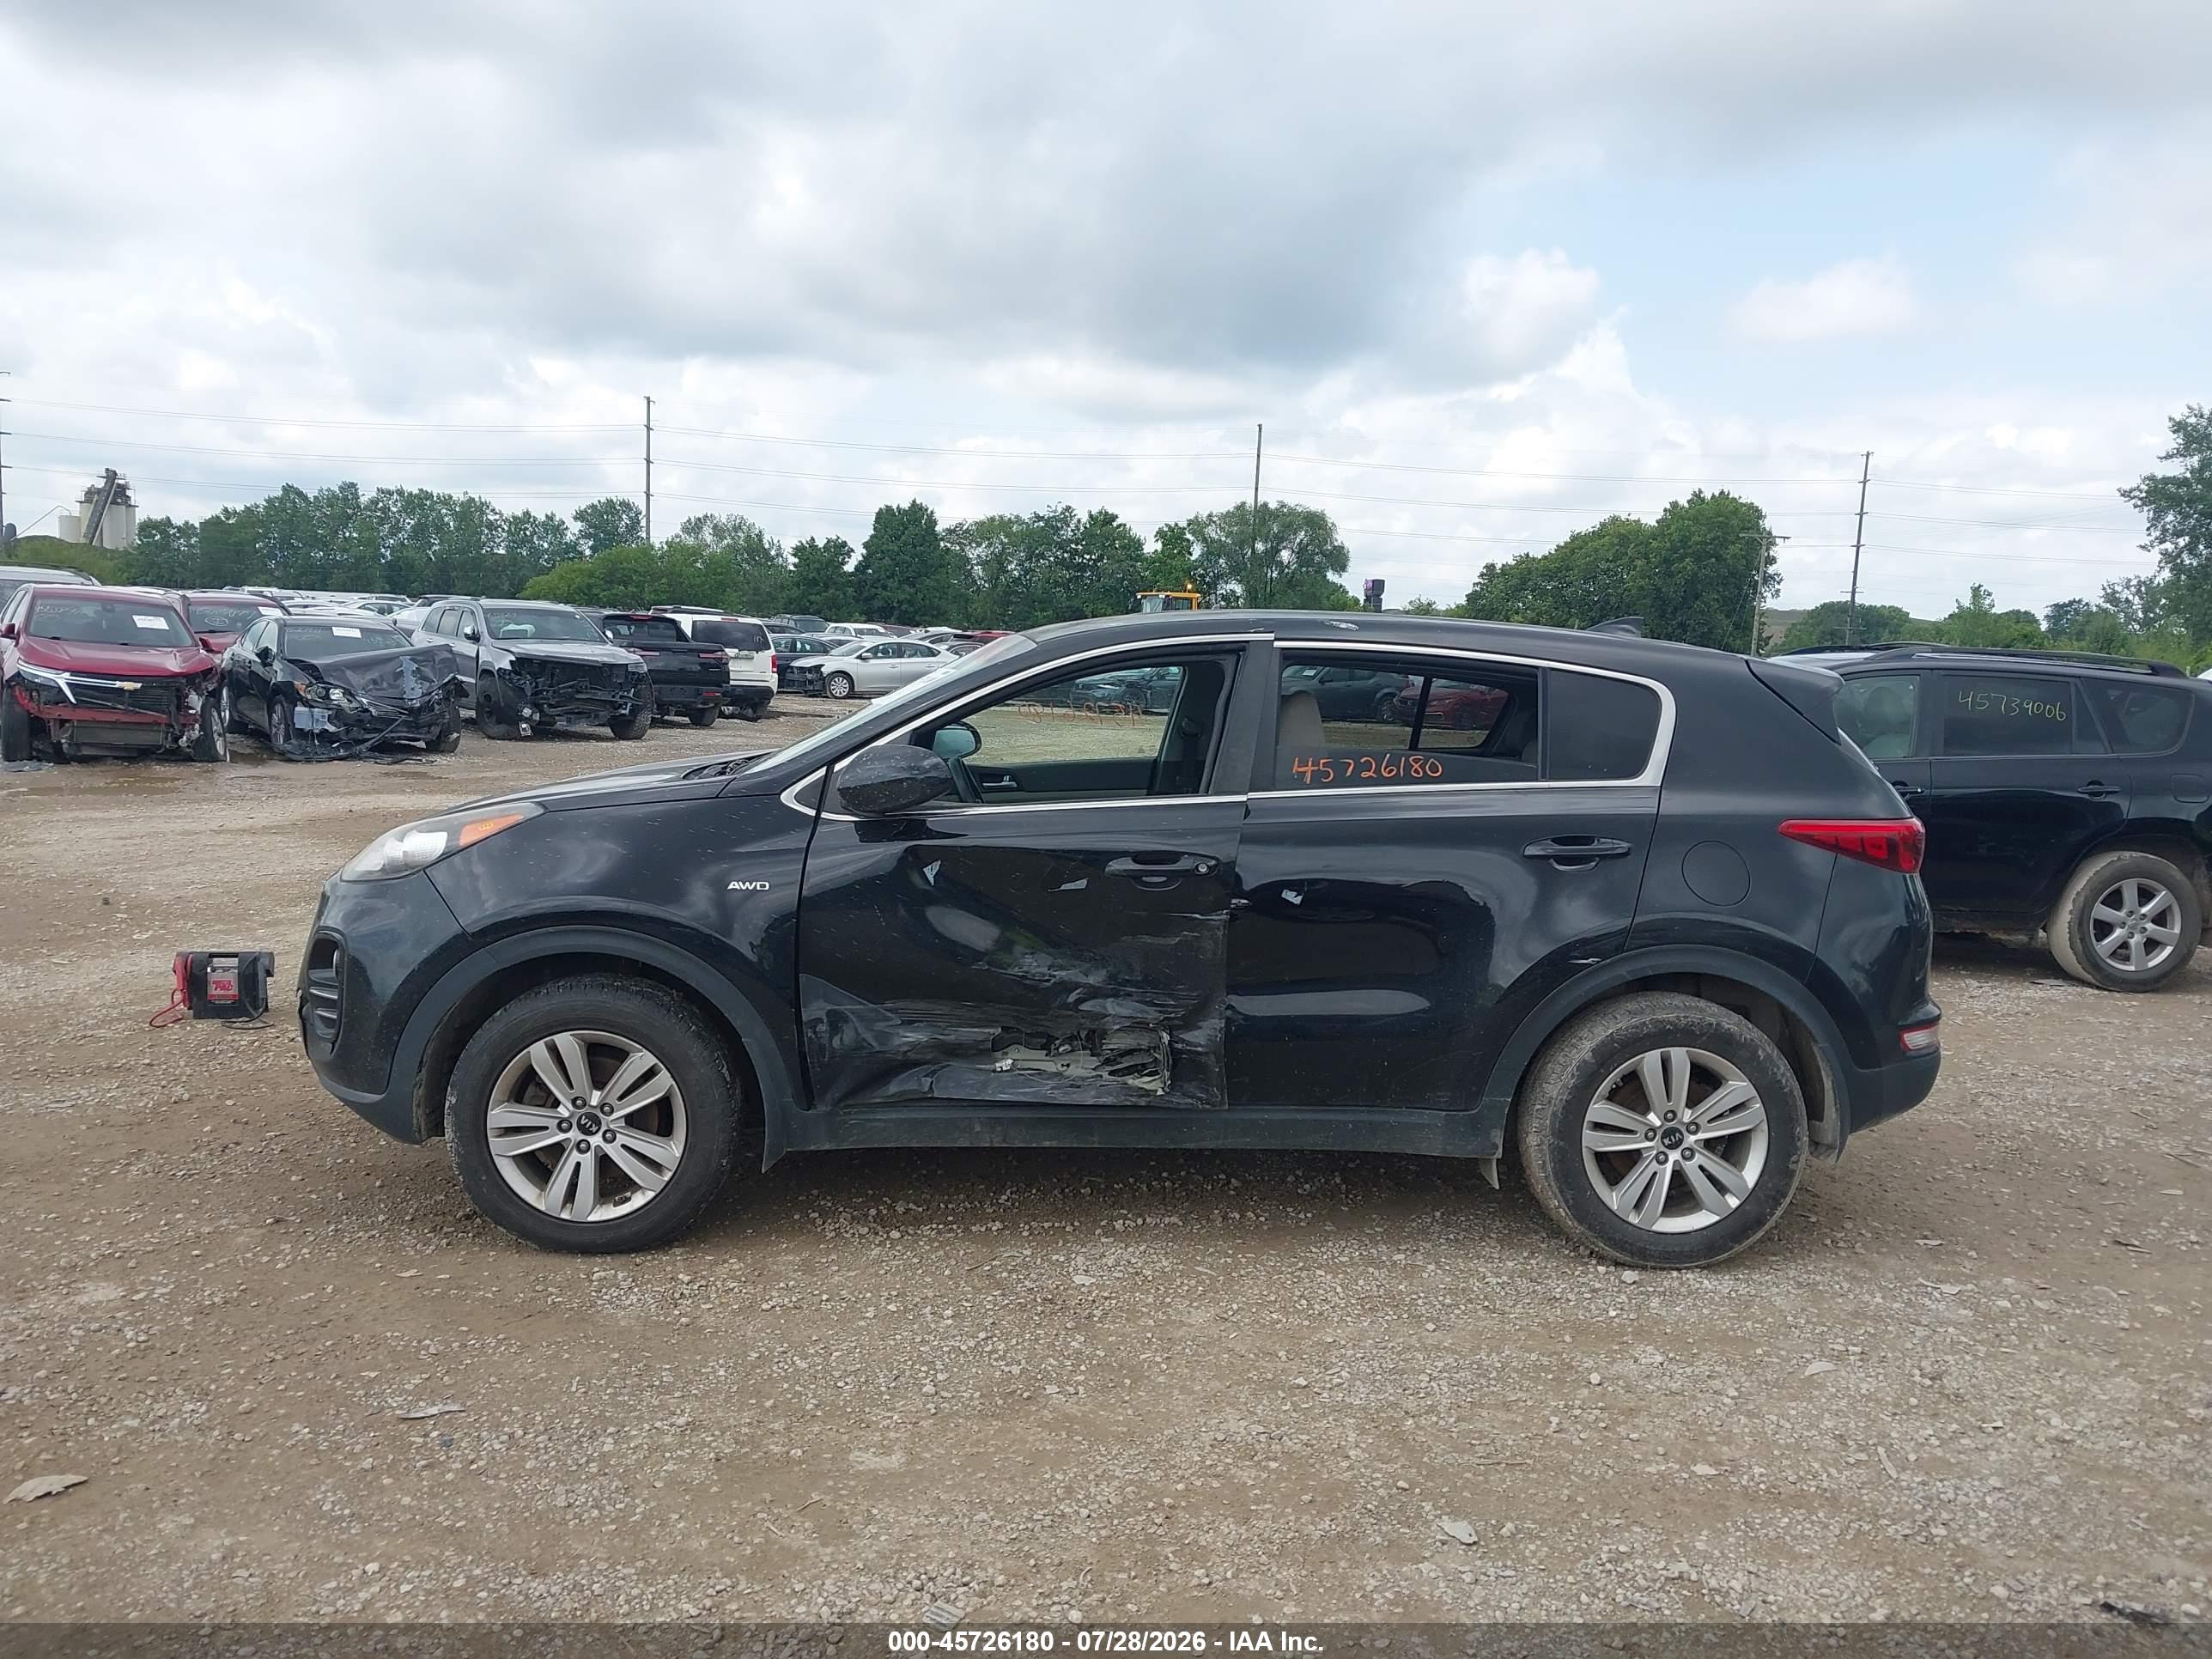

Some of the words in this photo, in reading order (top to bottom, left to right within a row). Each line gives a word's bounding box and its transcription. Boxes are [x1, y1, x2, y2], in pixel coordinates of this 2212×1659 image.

[1959, 690, 2067, 721] 45739006
[1291, 752, 1443, 784] 45726180
[726, 881, 769, 890] AWD
[580, 1115, 599, 1133] KIA
[1663, 1133, 1683, 1146] KIA
